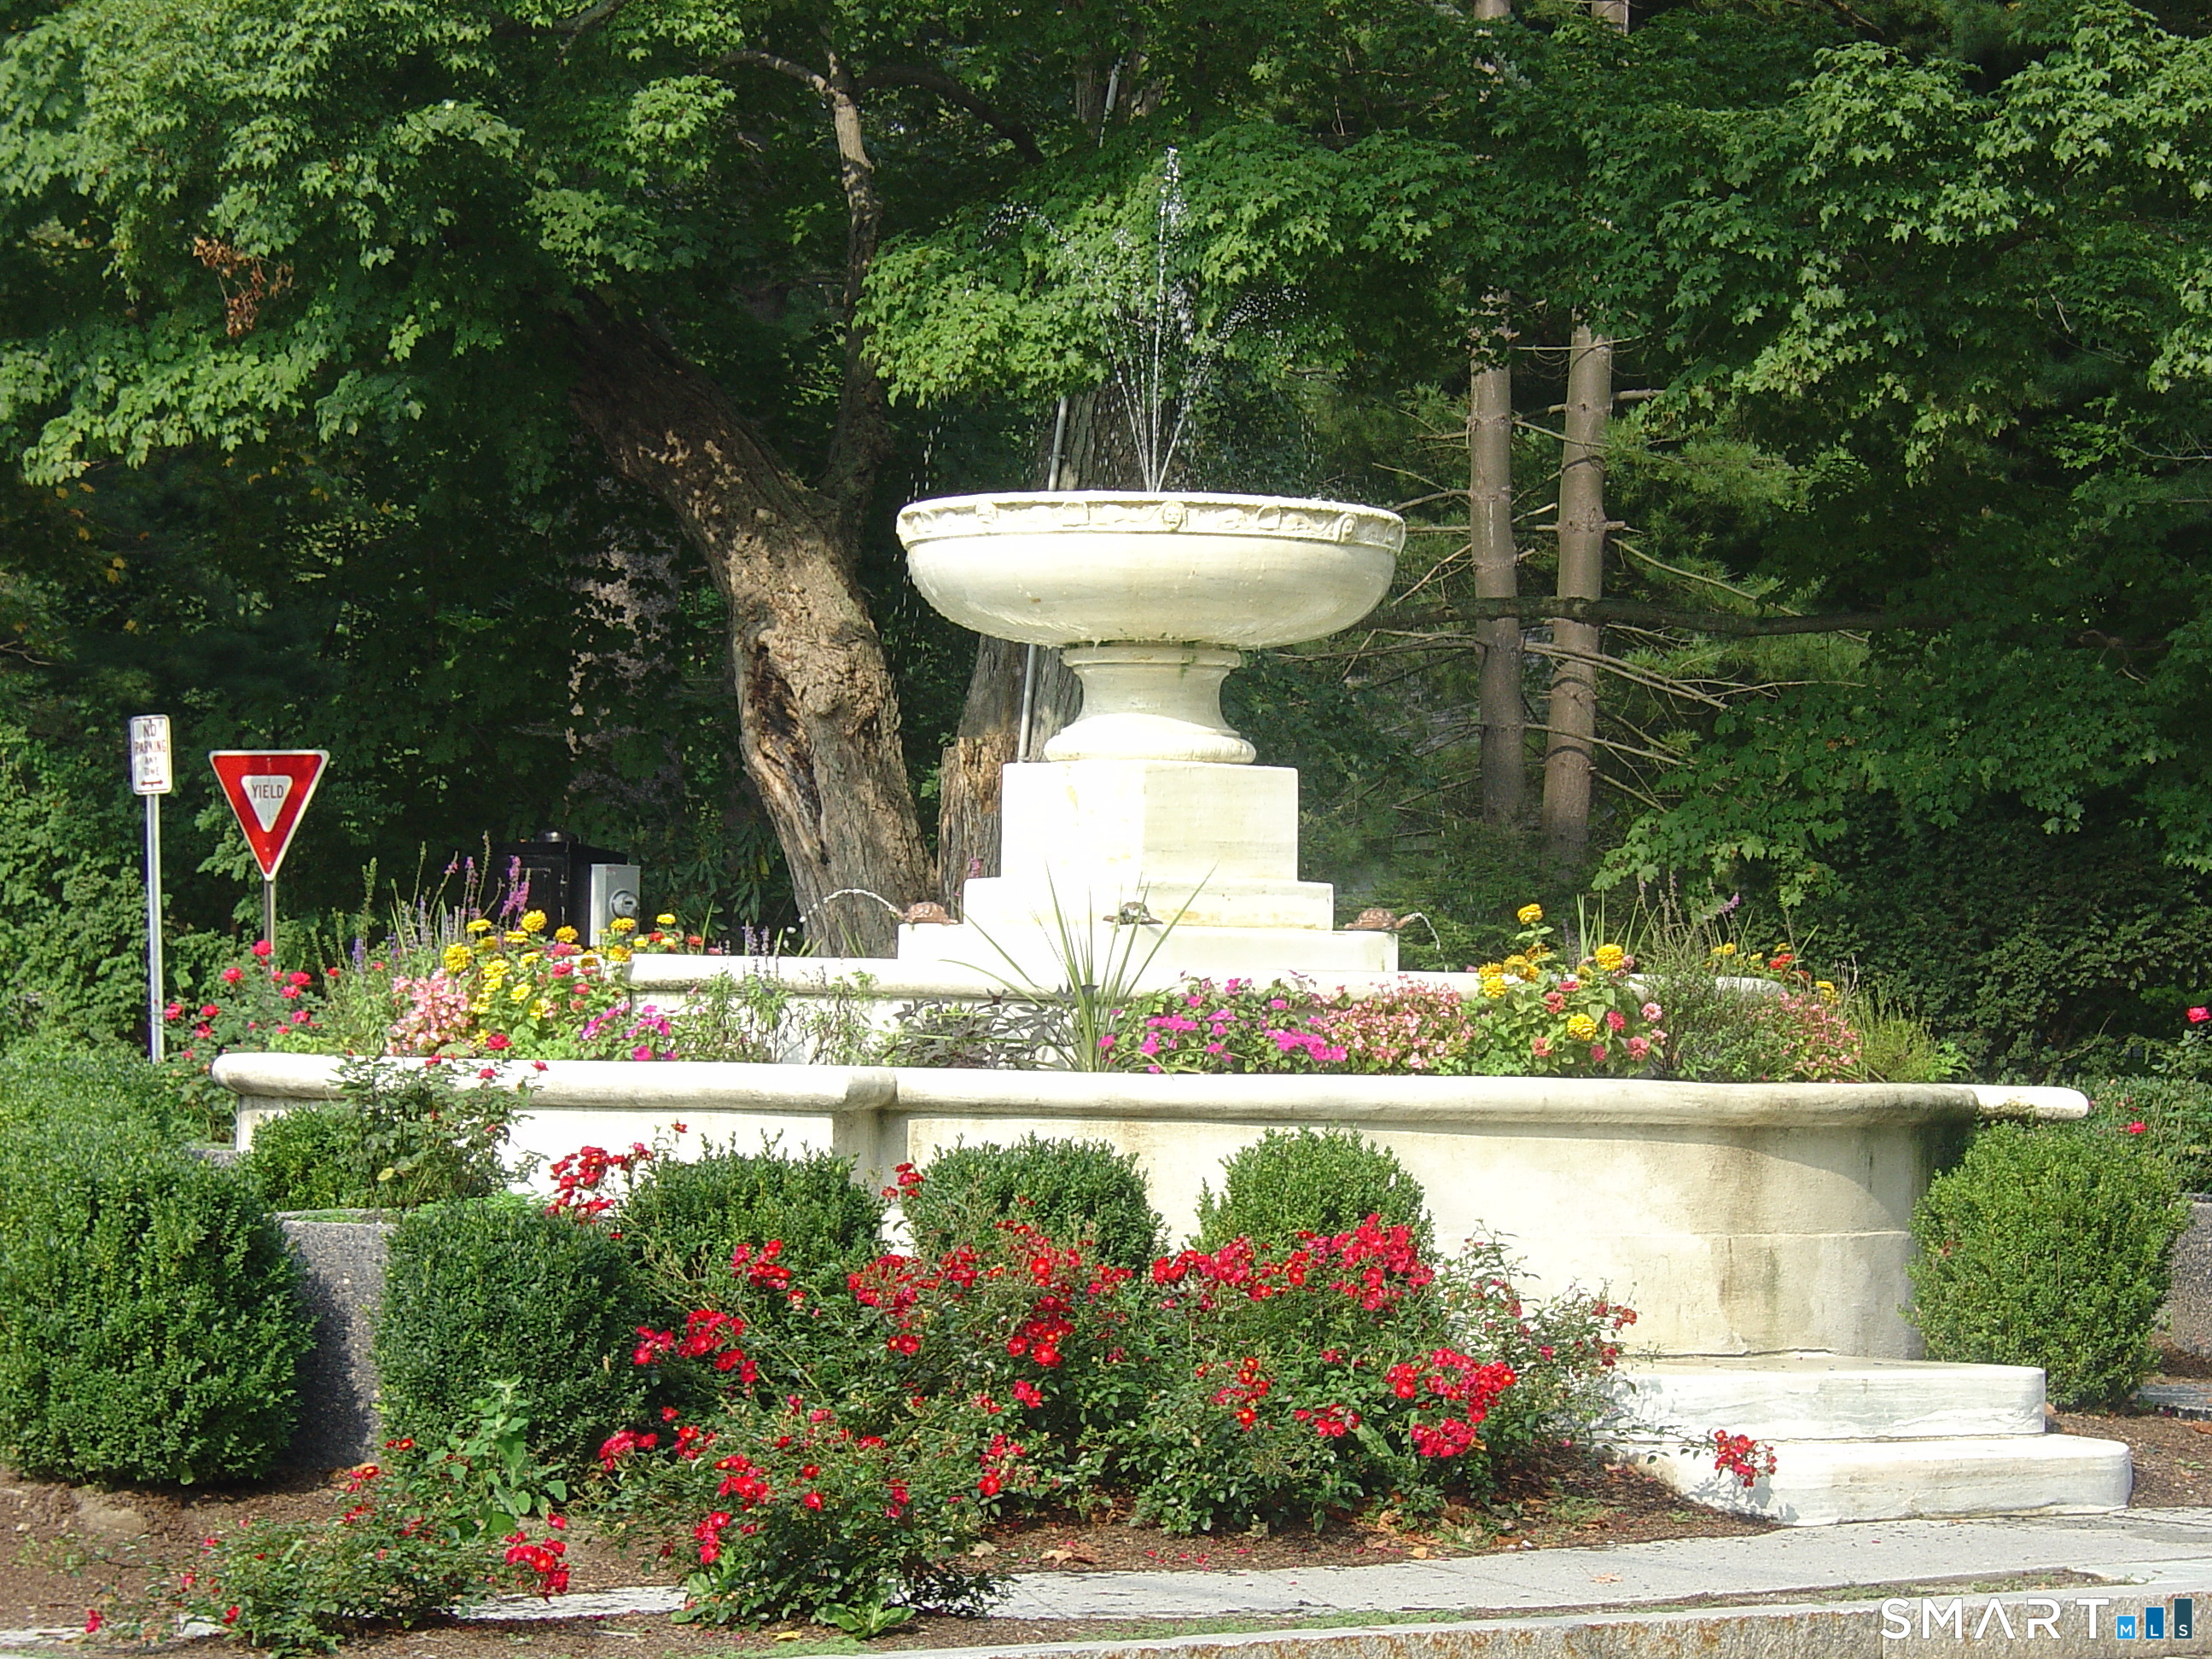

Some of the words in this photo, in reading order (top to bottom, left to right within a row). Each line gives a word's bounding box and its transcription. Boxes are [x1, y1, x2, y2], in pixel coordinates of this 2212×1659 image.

[143, 724, 156, 738] NO
[134, 740, 166, 757] PARKING
[252, 784, 284, 799] YIELD
